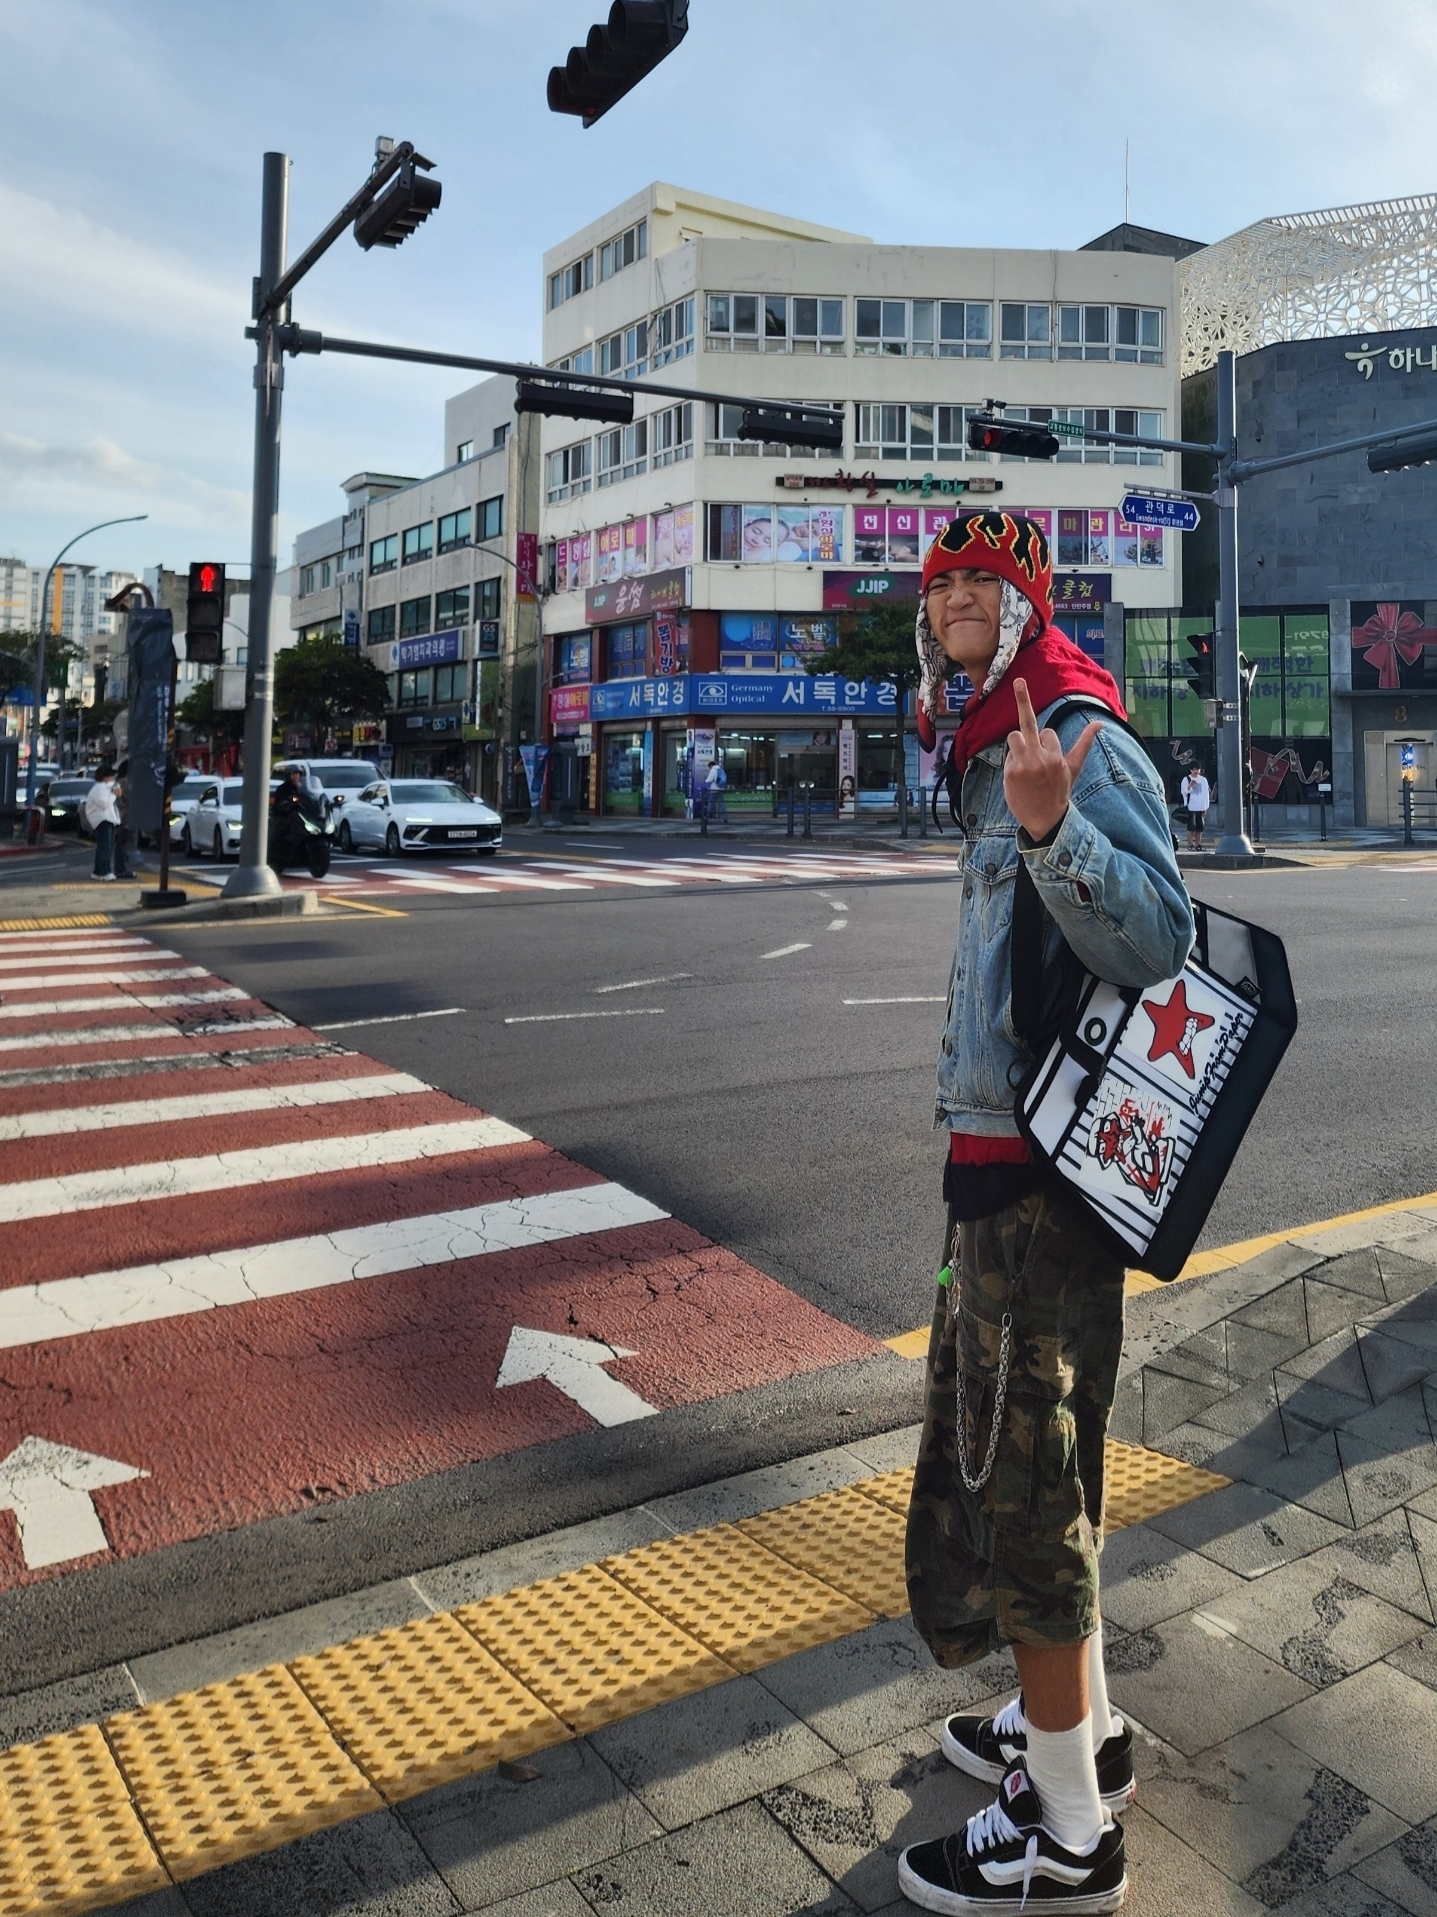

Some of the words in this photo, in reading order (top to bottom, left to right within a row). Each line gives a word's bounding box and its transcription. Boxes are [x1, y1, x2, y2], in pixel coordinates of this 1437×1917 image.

[895, 472, 964, 499] 아로마
[1125, 505, 1135, 514] 54
[1145, 501, 1175, 514] 관덕로
[1184, 513, 1194, 521] 44
[819, 535, 834, 560] 아로마
[857, 580, 889, 593] JJIP
[1062, 579, 1094, 599] 클럽
[483, 623, 495, 632] GS
[658, 624, 674, 674] 뽑기방
[629, 681, 684, 707] 서독안경
[731, 684, 774, 693] Germany
[781, 681, 897, 706] 서독안경
[731, 694, 765, 704] Optical
[1394, 705, 1408, 723] 8
